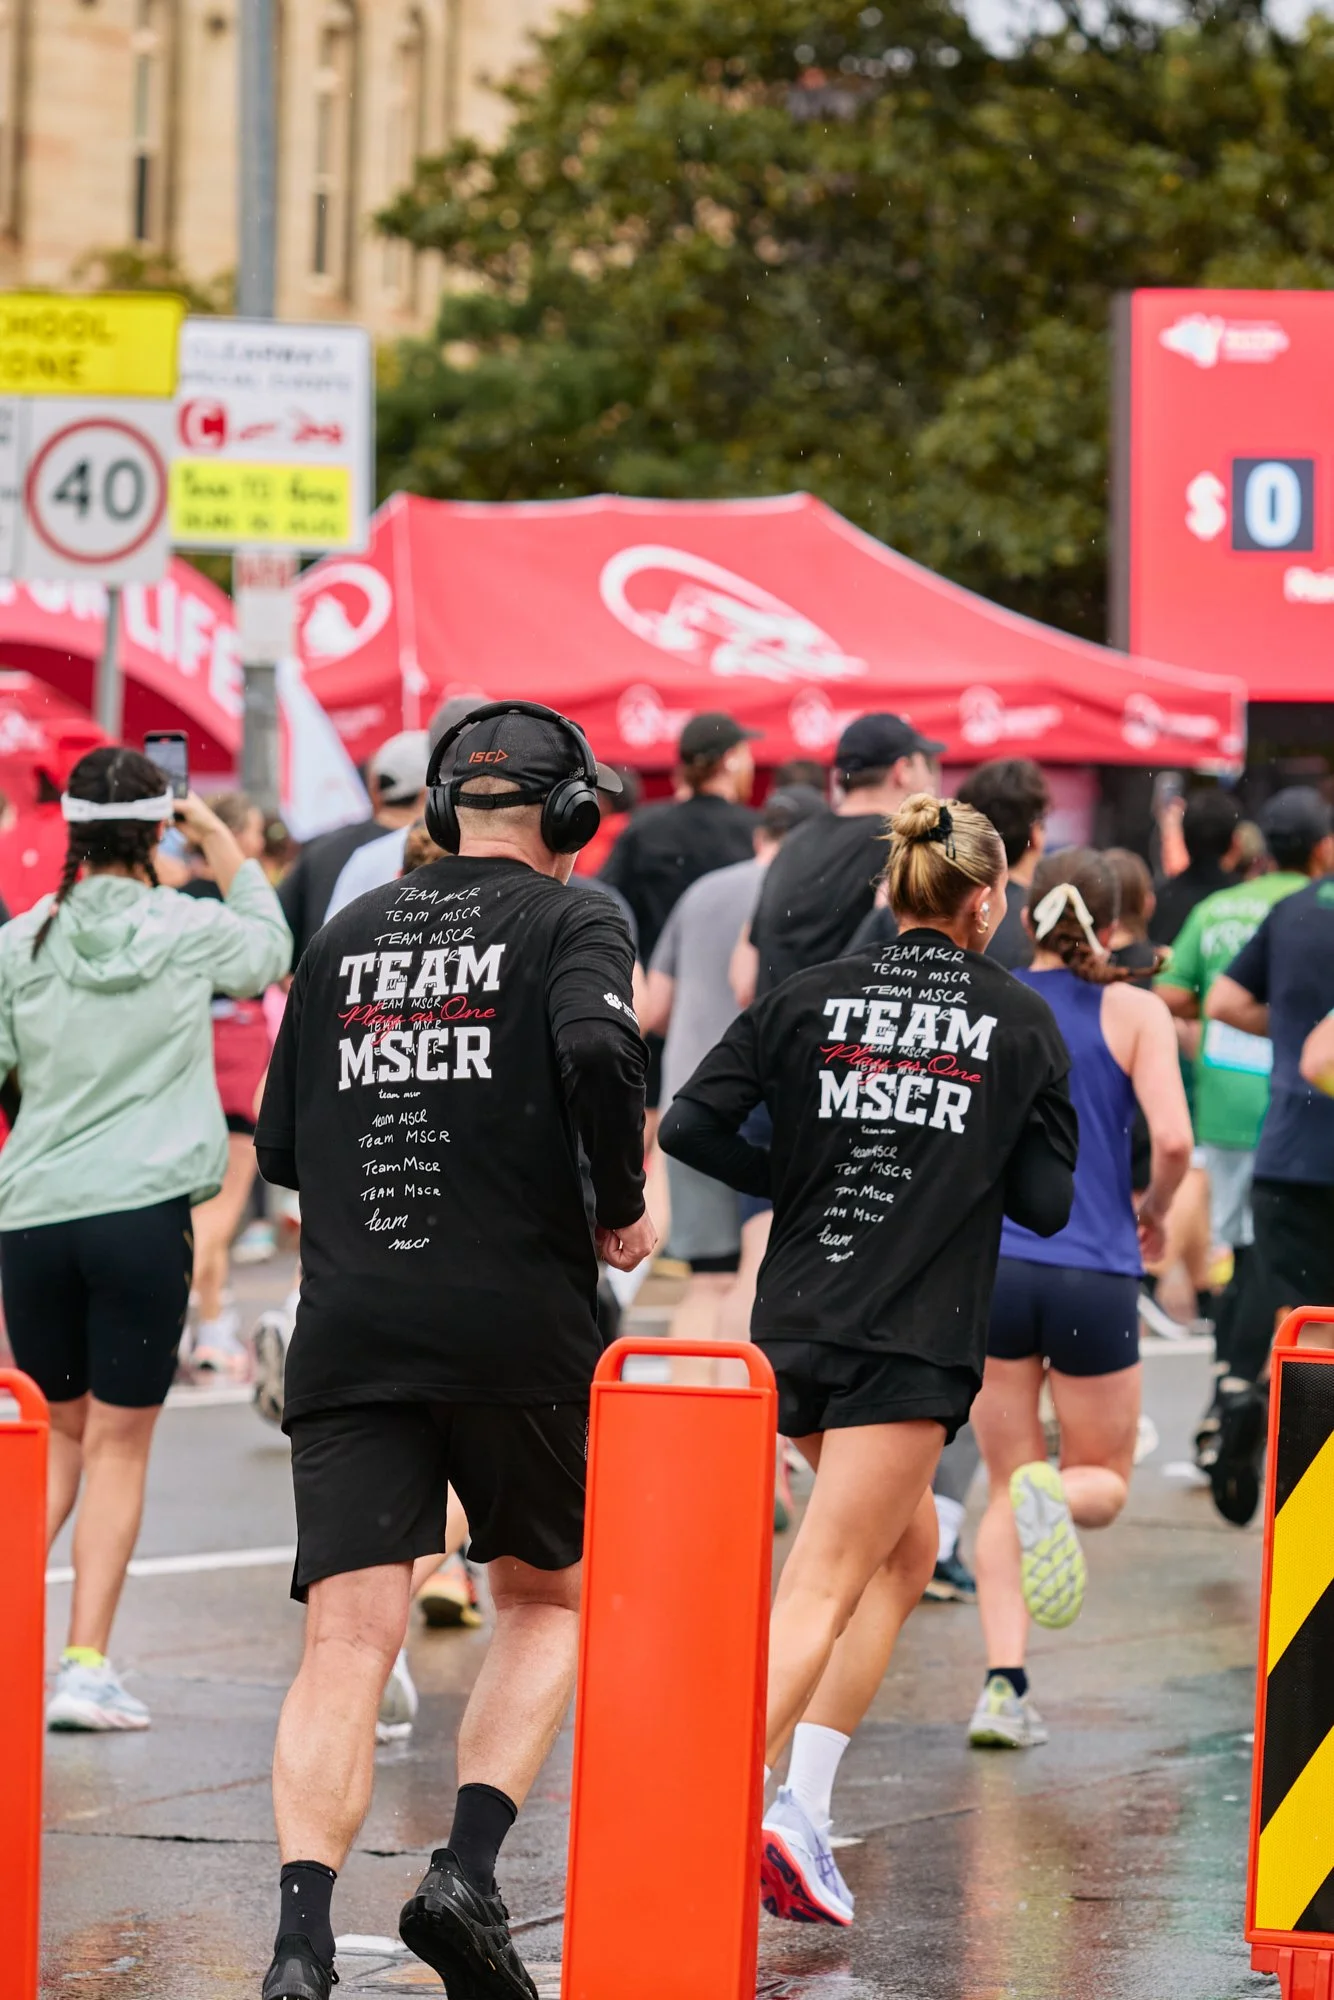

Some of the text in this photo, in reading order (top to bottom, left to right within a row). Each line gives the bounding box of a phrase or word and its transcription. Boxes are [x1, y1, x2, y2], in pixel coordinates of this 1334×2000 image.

[0, 309, 117, 348] HOOL
[0, 349, 86, 386] ONE
[51, 460, 148, 522] 40
[1185, 461, 1303, 549] $ 0
[469, 752, 495, 763] ISC
[386, 910, 429, 922] TEAM
[375, 926, 475, 946] TEAM MSCR
[882, 946, 919, 962] TEAM
[339, 944, 506, 1004] TEAM
[872, 963, 917, 978] TEAM
[862, 986, 968, 1004] TEAM MSCR
[338, 996, 496, 1046] Play as One
[823, 999, 998, 1061] TEAM
[339, 1027, 492, 1090] MSCR
[820, 1044, 982, 1085] Play as One
[379, 1088, 399, 1099] team
[819, 1070, 972, 1134] MSCR
[399, 1109, 427, 1125] MSCR
[359, 1130, 450, 1148] Team MSCR
[363, 1160, 400, 1176] Team
[870, 1162, 912, 1180] MSCR
[361, 1187, 394, 1201] TEAM
[365, 1208, 408, 1231] team
[817, 1224, 853, 1246] team
